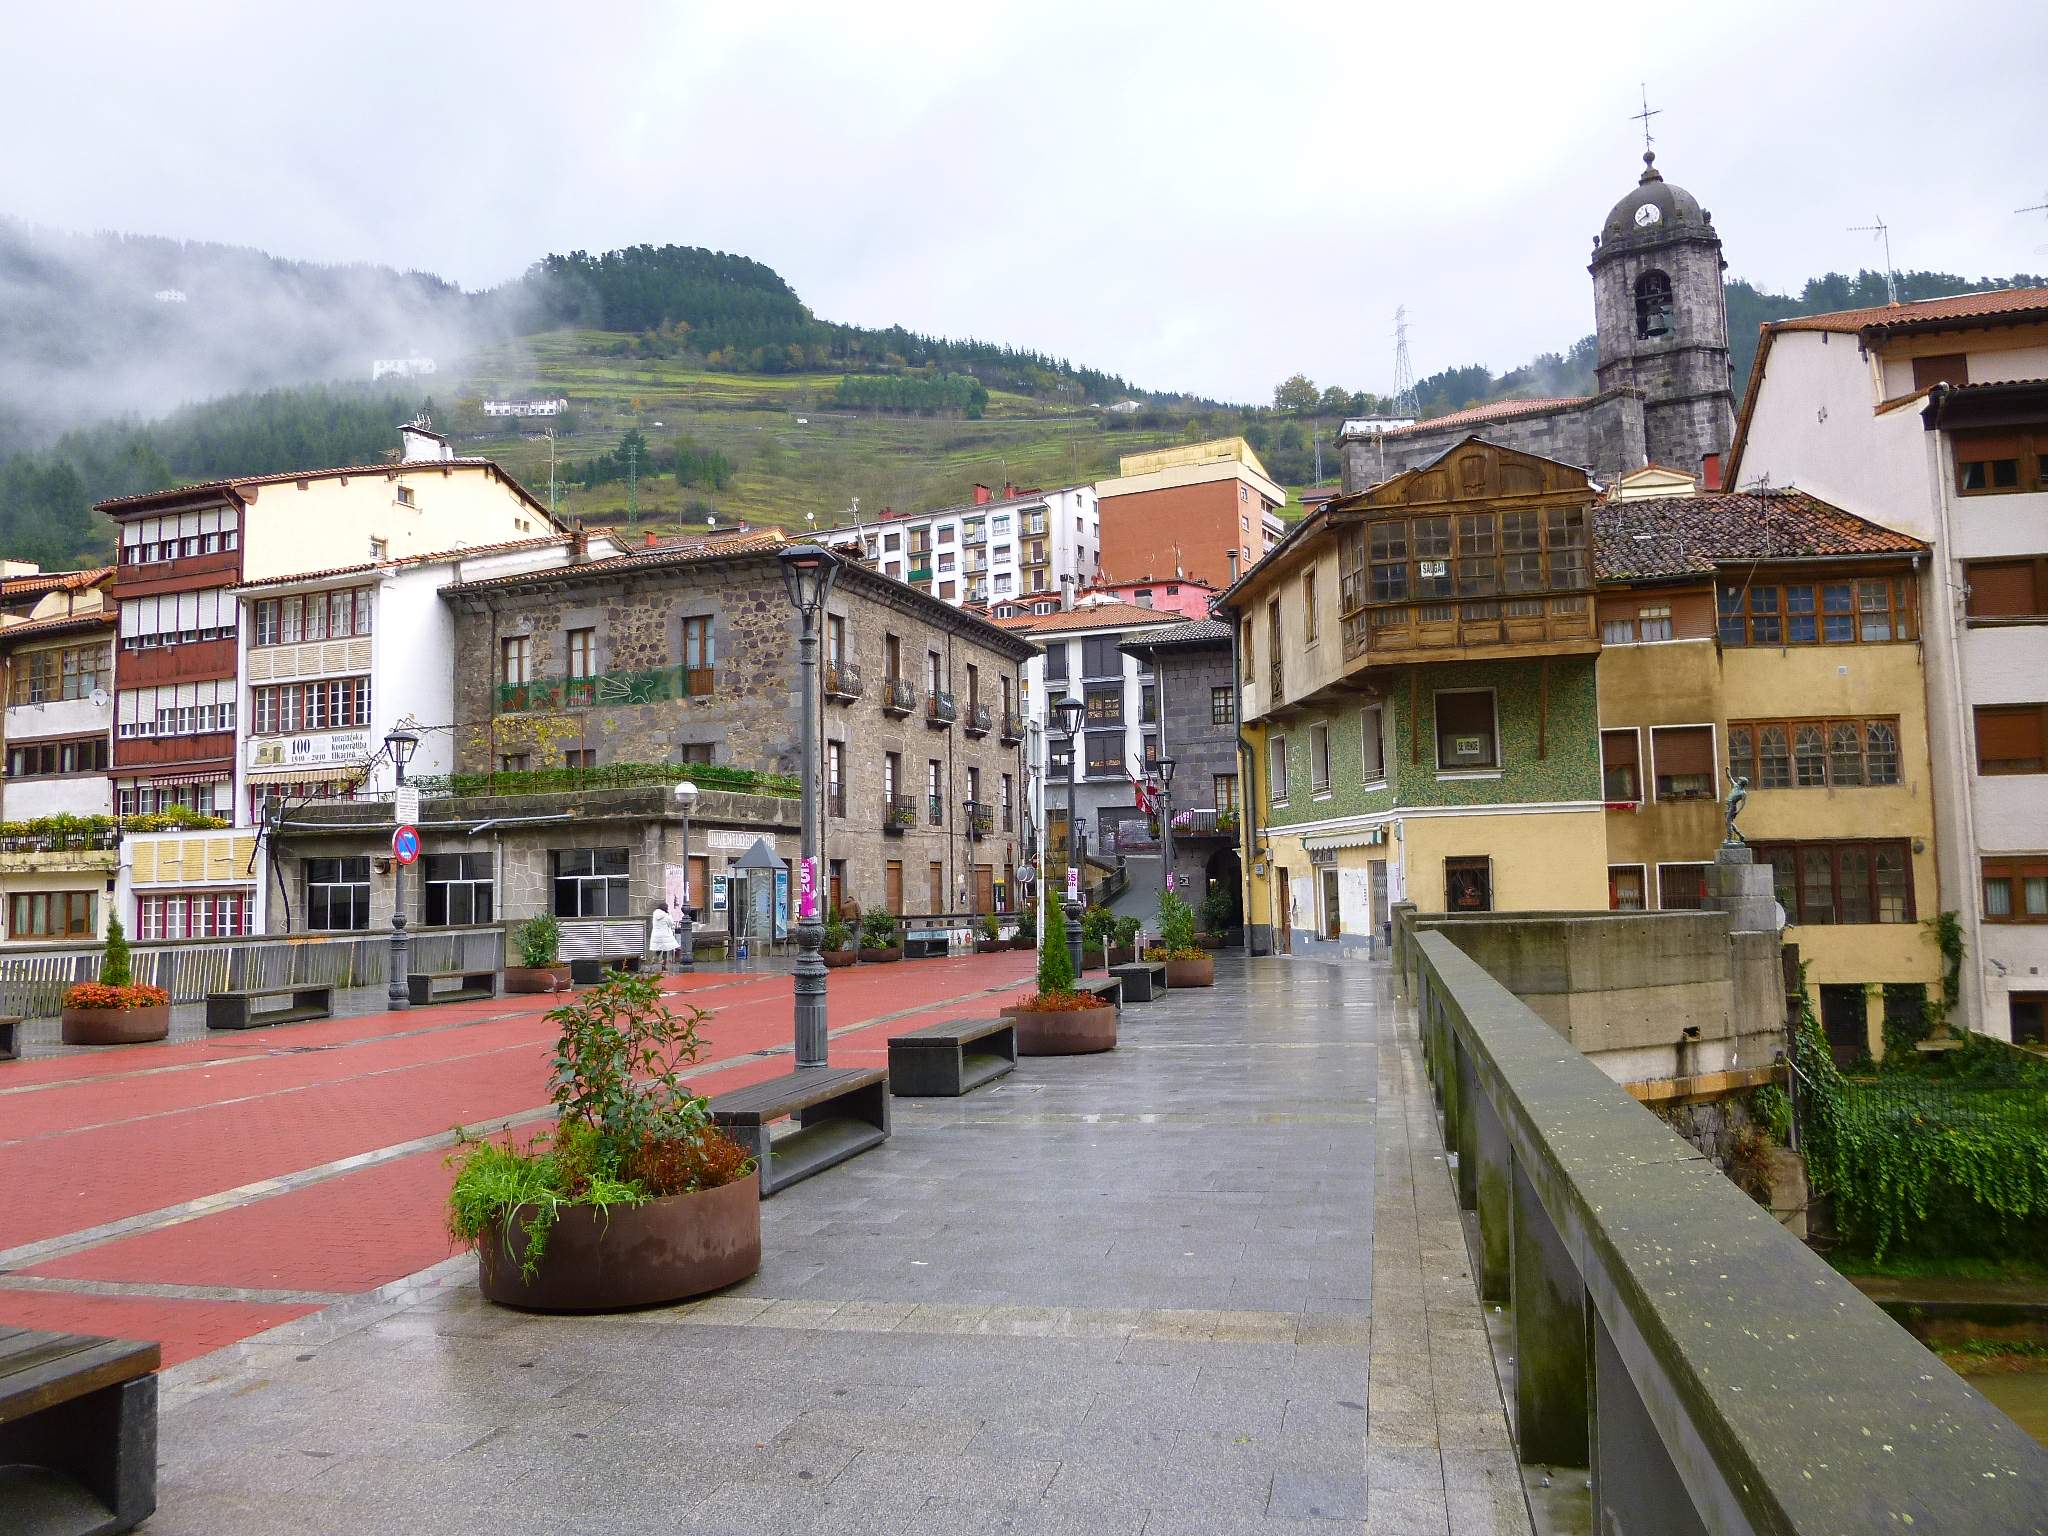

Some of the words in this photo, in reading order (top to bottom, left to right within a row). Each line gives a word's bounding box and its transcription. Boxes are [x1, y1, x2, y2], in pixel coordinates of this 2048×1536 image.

[292, 738, 310, 754] 100
[291, 755, 305, 763] 1910
[709, 832, 745, 847] JUVENTUD
